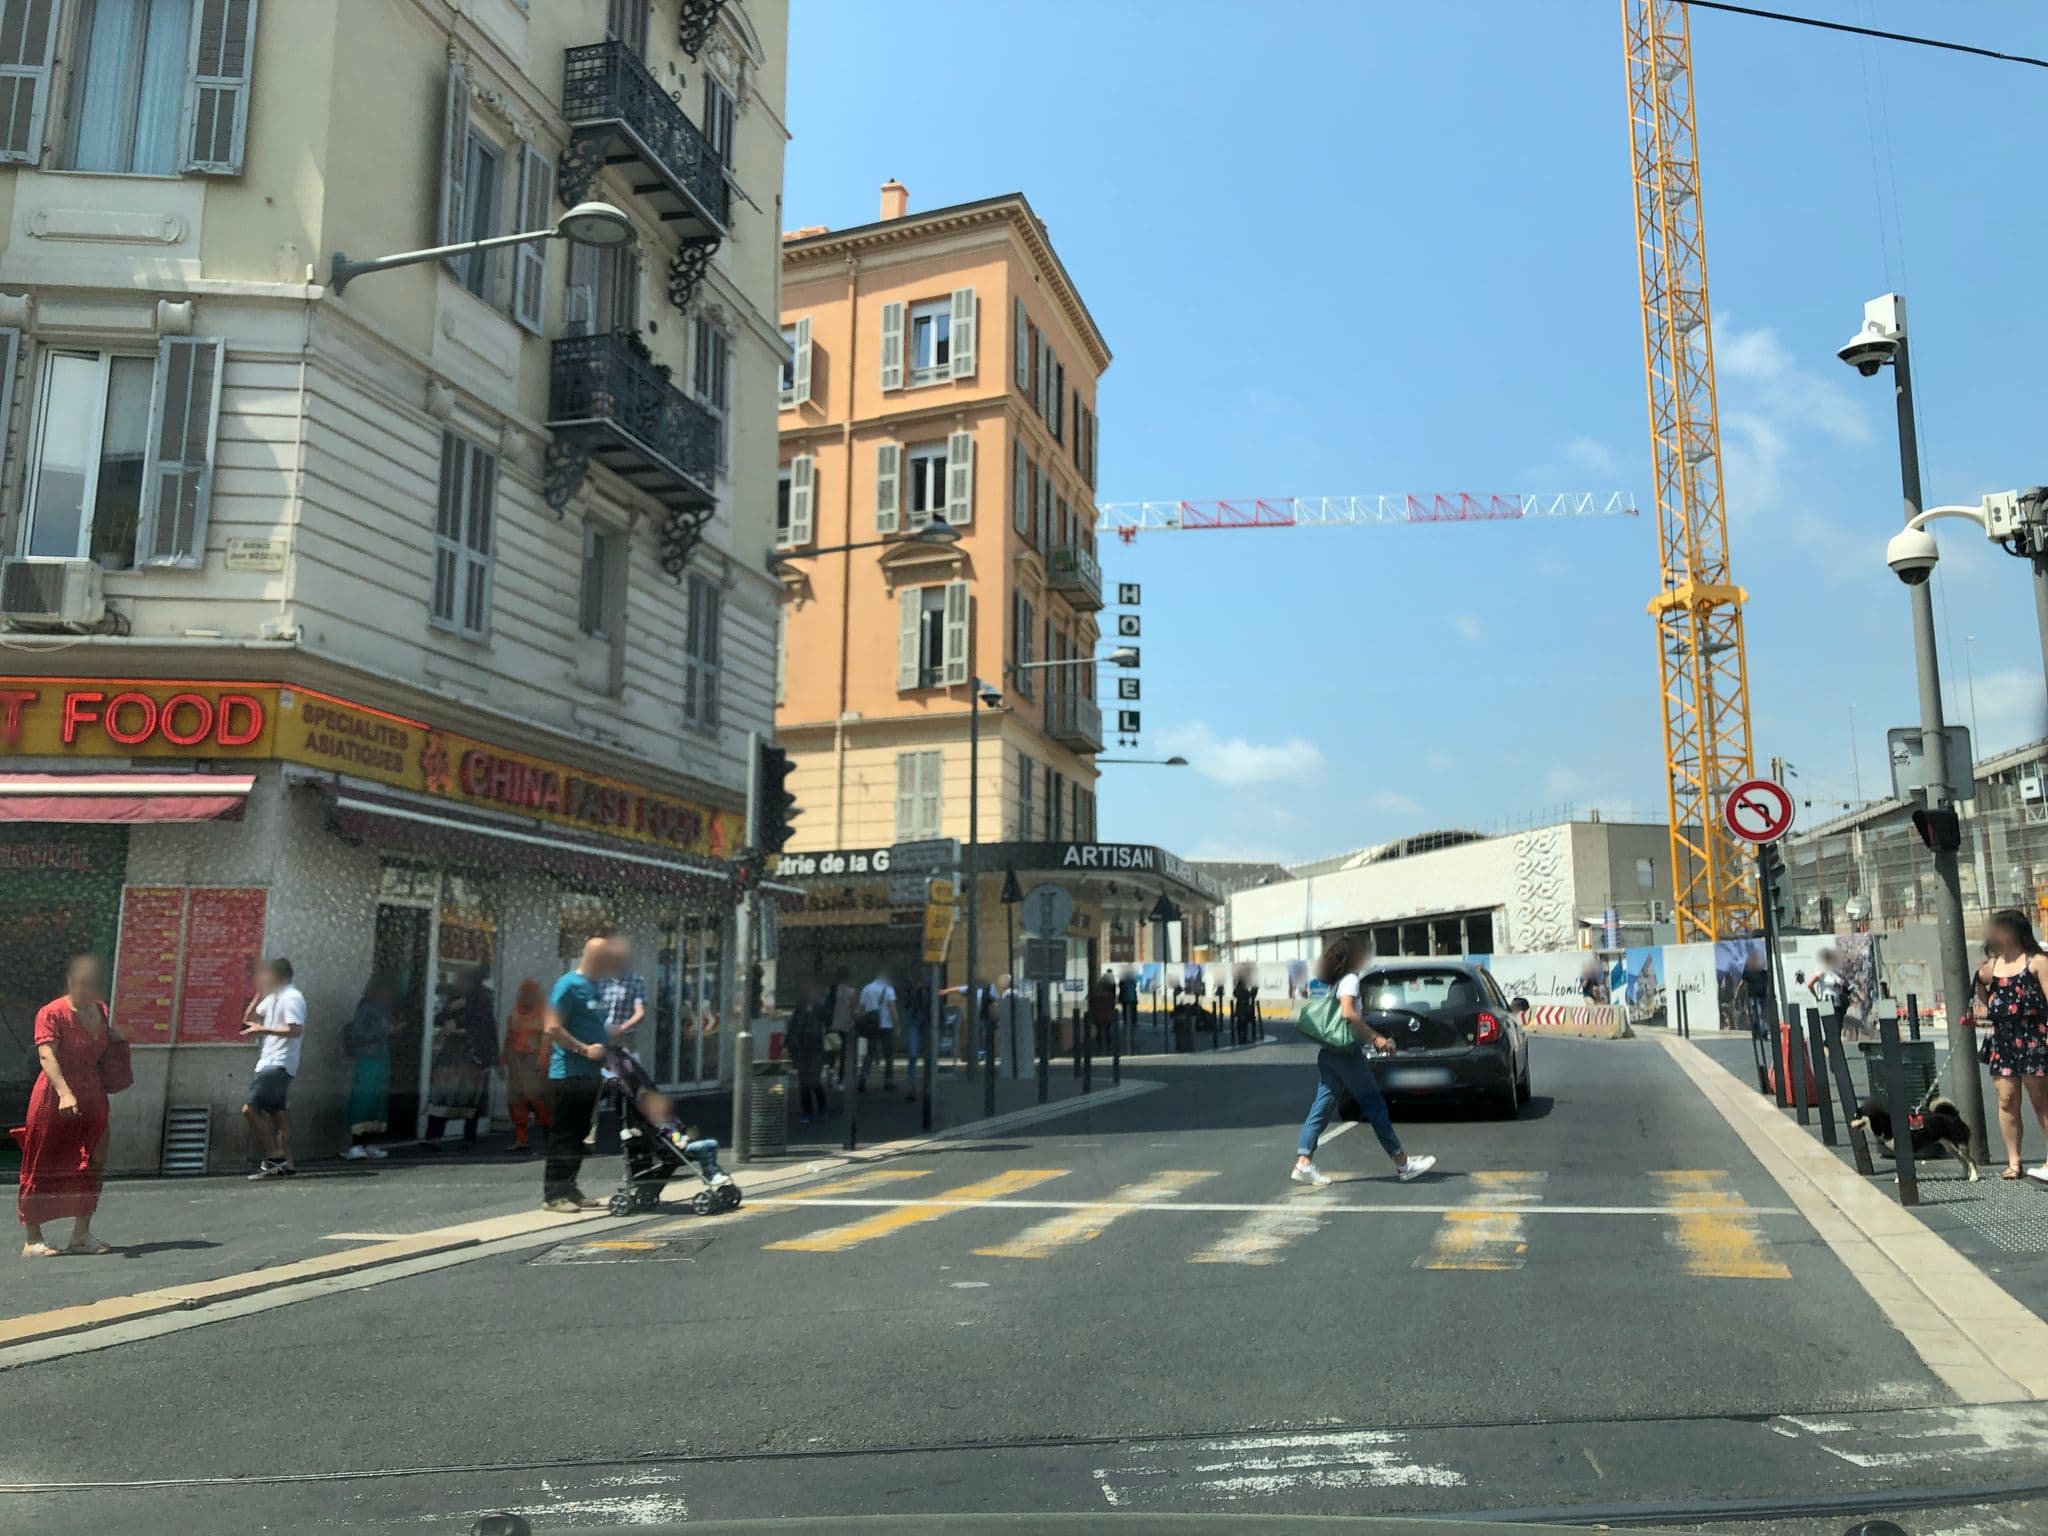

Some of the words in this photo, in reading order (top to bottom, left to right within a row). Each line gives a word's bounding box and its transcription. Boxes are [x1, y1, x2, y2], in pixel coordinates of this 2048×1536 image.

[1119, 584, 1140, 731] HOEL
[63, 690, 265, 747] FOOD
[460, 749, 562, 814] CHINA
[564, 775, 637, 828] FAST
[819, 853, 846, 874] de
[849, 853, 869, 873] la
[1063, 845, 1154, 868] ARTISAN
